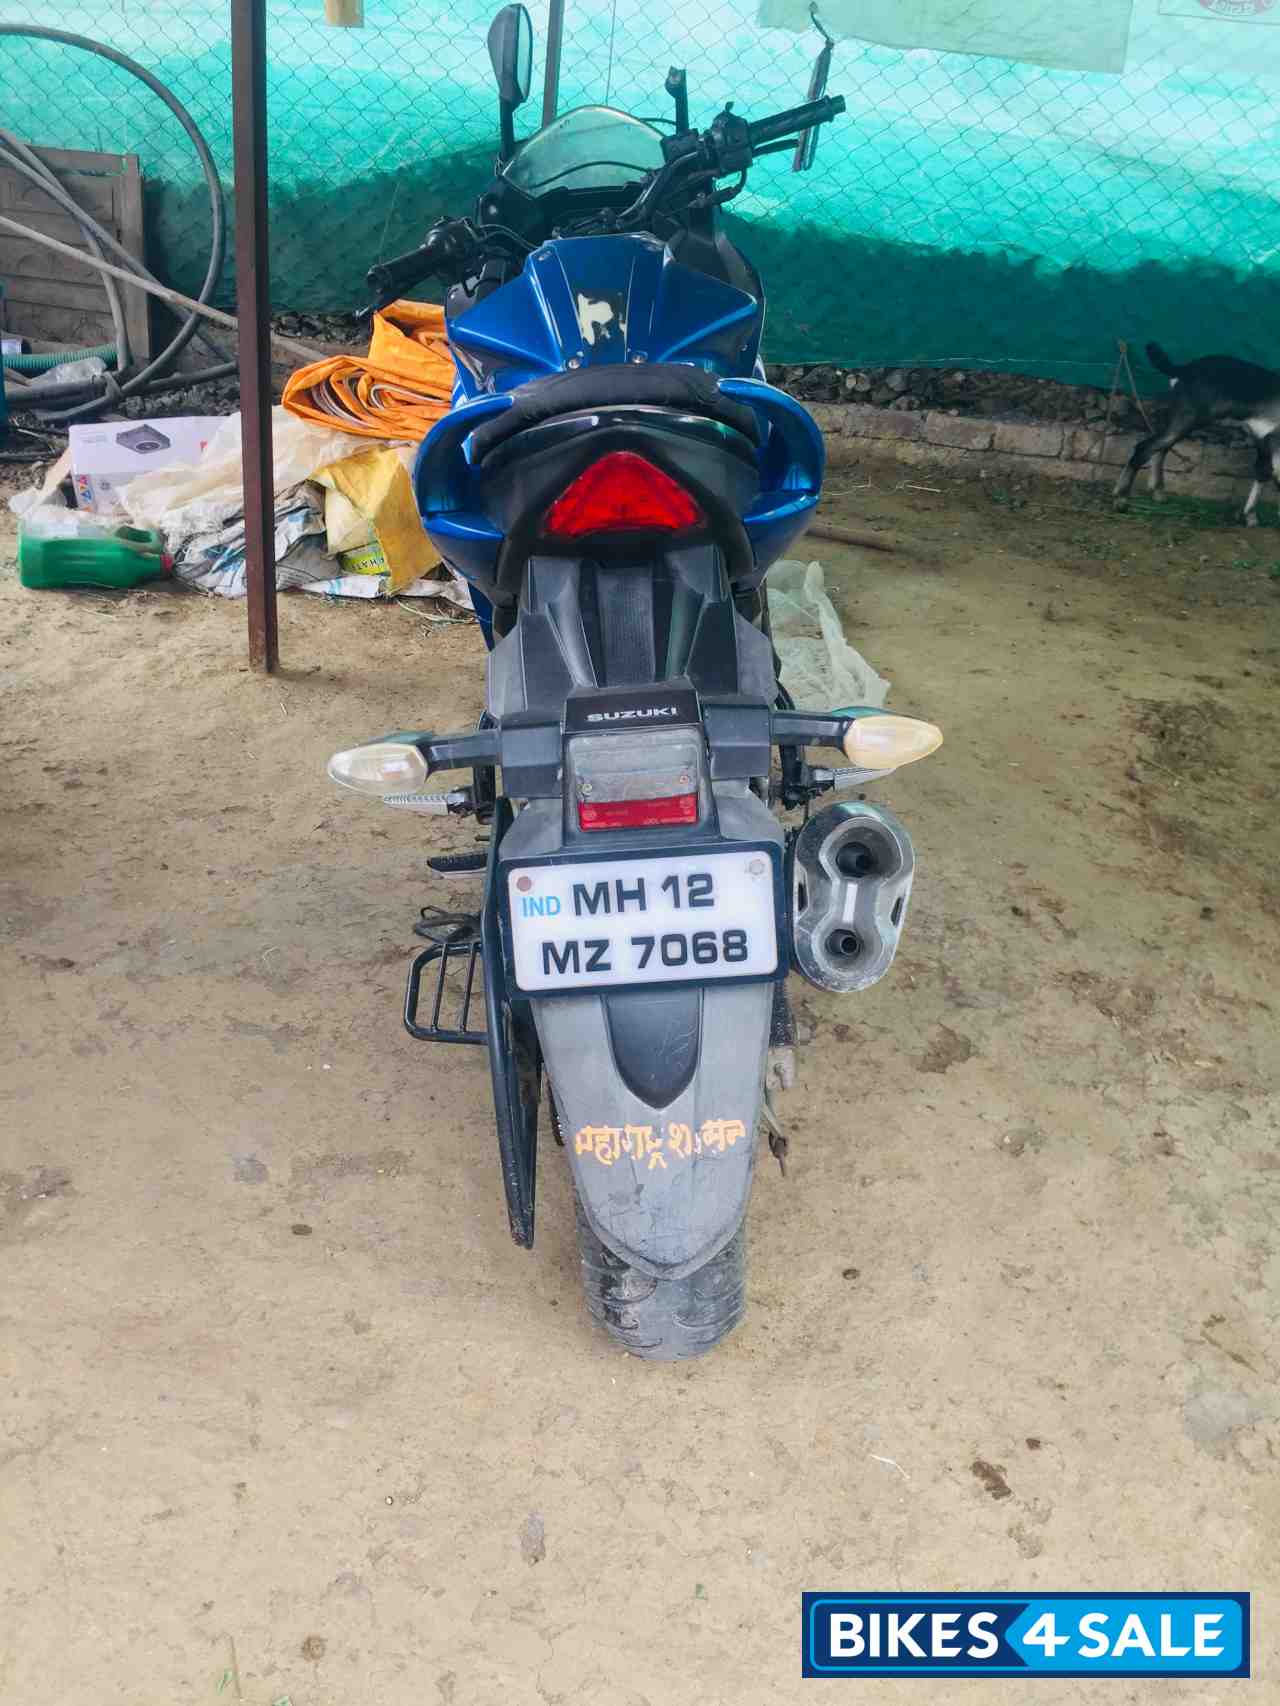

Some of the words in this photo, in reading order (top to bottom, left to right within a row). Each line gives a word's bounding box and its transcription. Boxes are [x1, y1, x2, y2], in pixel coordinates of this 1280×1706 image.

[586, 707, 677, 722] SUZUKI
[522, 896, 560, 917] IND
[573, 878, 646, 916] MH
[661, 873, 715, 908] 12
[542, 939, 611, 975] MZ
[631, 929, 748, 968] 7068
